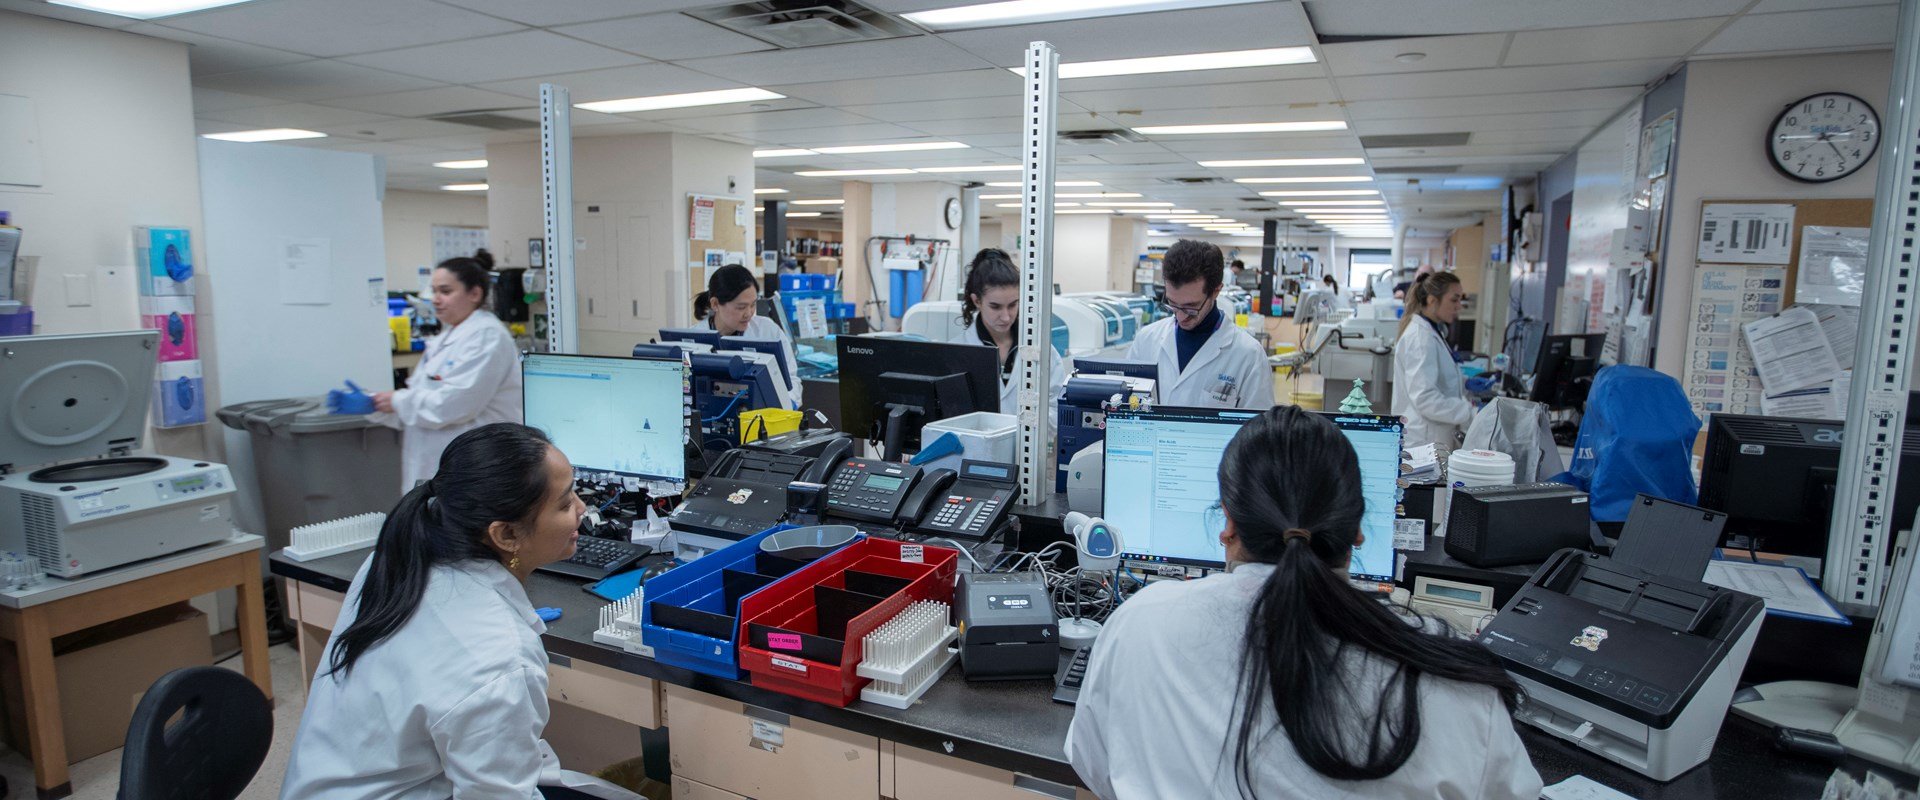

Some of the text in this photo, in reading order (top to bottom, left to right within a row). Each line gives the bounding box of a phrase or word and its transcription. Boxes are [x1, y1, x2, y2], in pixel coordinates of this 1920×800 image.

[1803, 104, 1812, 114] 11
[1823, 99, 1836, 109] 12
[1847, 102, 1852, 113] 1
[1785, 117, 1797, 126] 10
[1859, 114, 1868, 125] 2
[1779, 134, 1787, 144] 9
[1862, 131, 1870, 142] 3
[1782, 151, 1791, 161] 8
[1852, 149, 1861, 160] 4
[1797, 163, 1806, 173] 7
[1816, 166, 1824, 177] 6
[1837, 162, 1845, 173] 5
[847, 345, 874, 355] Lenovo
[1814, 429, 1844, 443] ac
